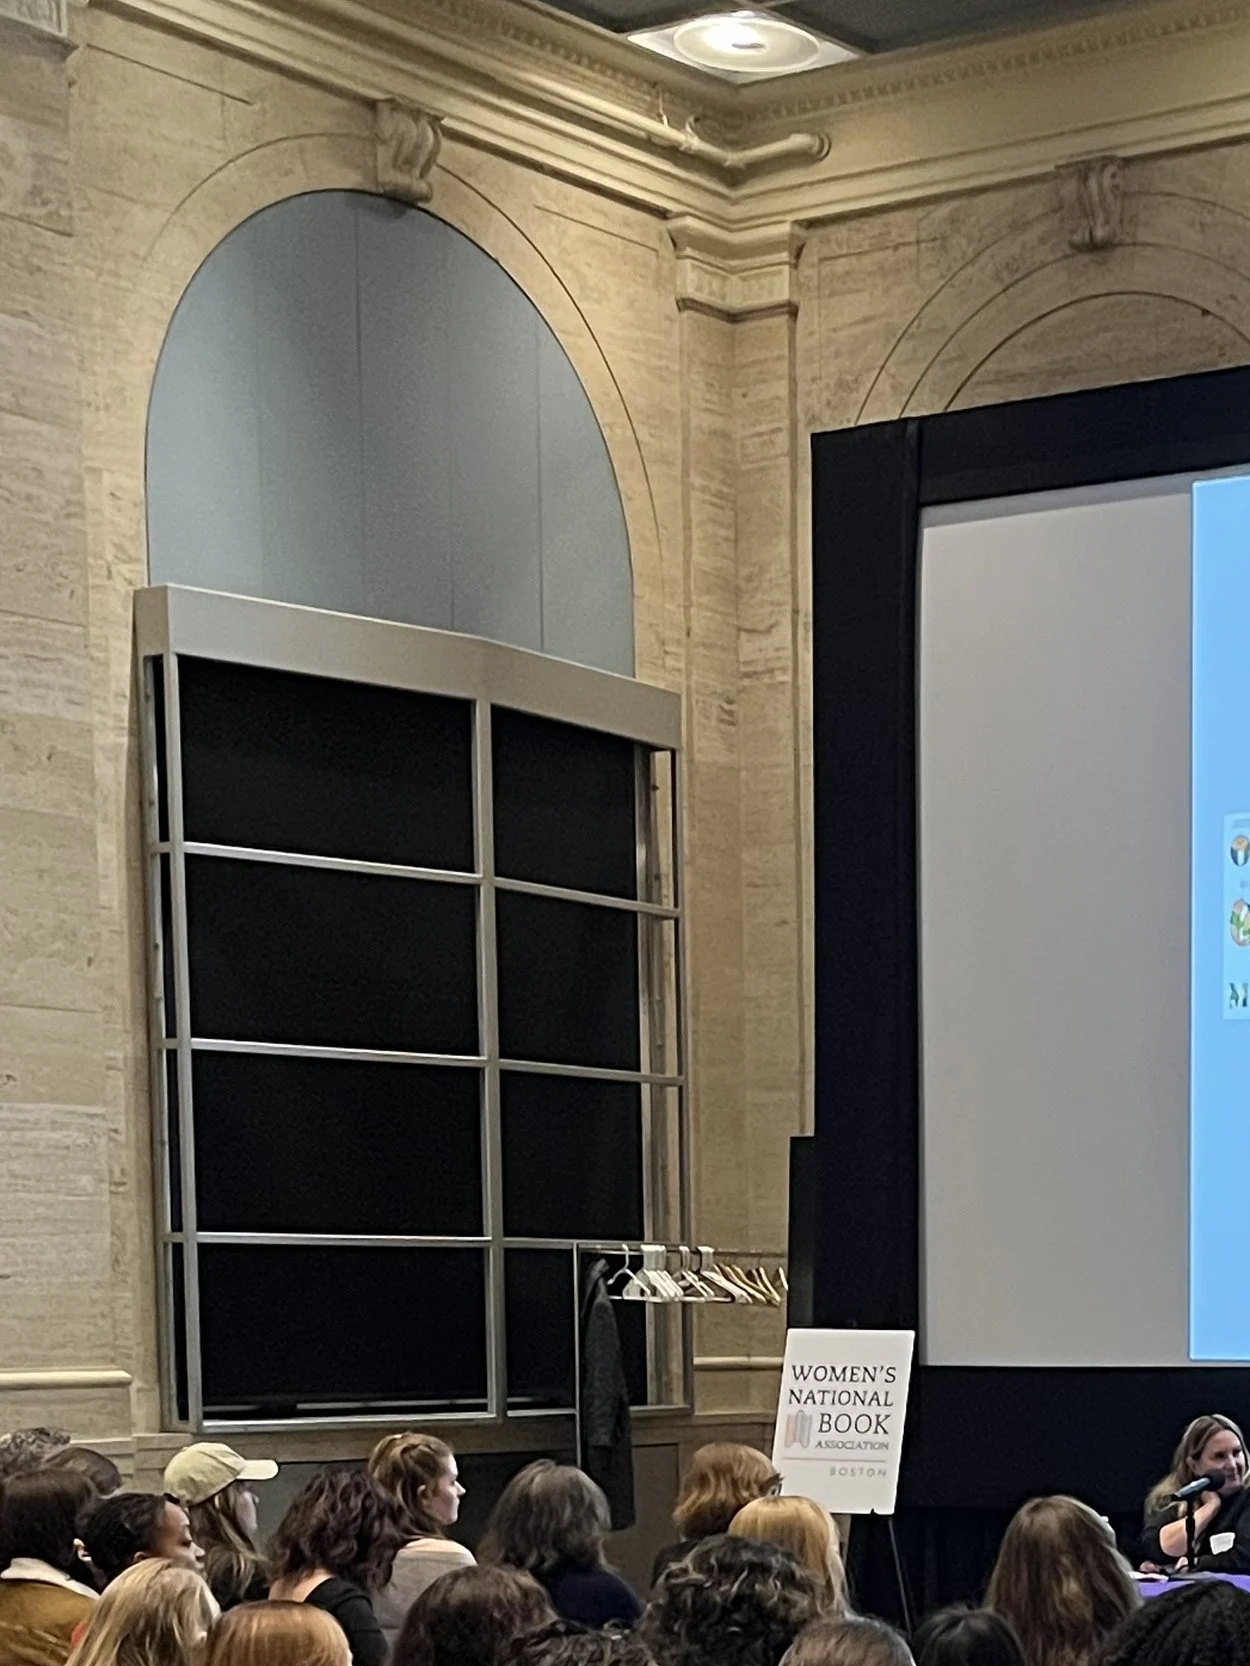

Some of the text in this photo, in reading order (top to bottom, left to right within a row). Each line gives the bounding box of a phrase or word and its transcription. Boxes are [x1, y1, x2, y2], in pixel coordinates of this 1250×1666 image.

[792, 1365, 896, 1383] WOMEN'S
[789, 1389, 893, 1407] NATIONAL
[818, 1413, 891, 1434] BOOK
[815, 1441, 889, 1450] ASSOCIATION
[830, 1467, 886, 1477] BOSTON
